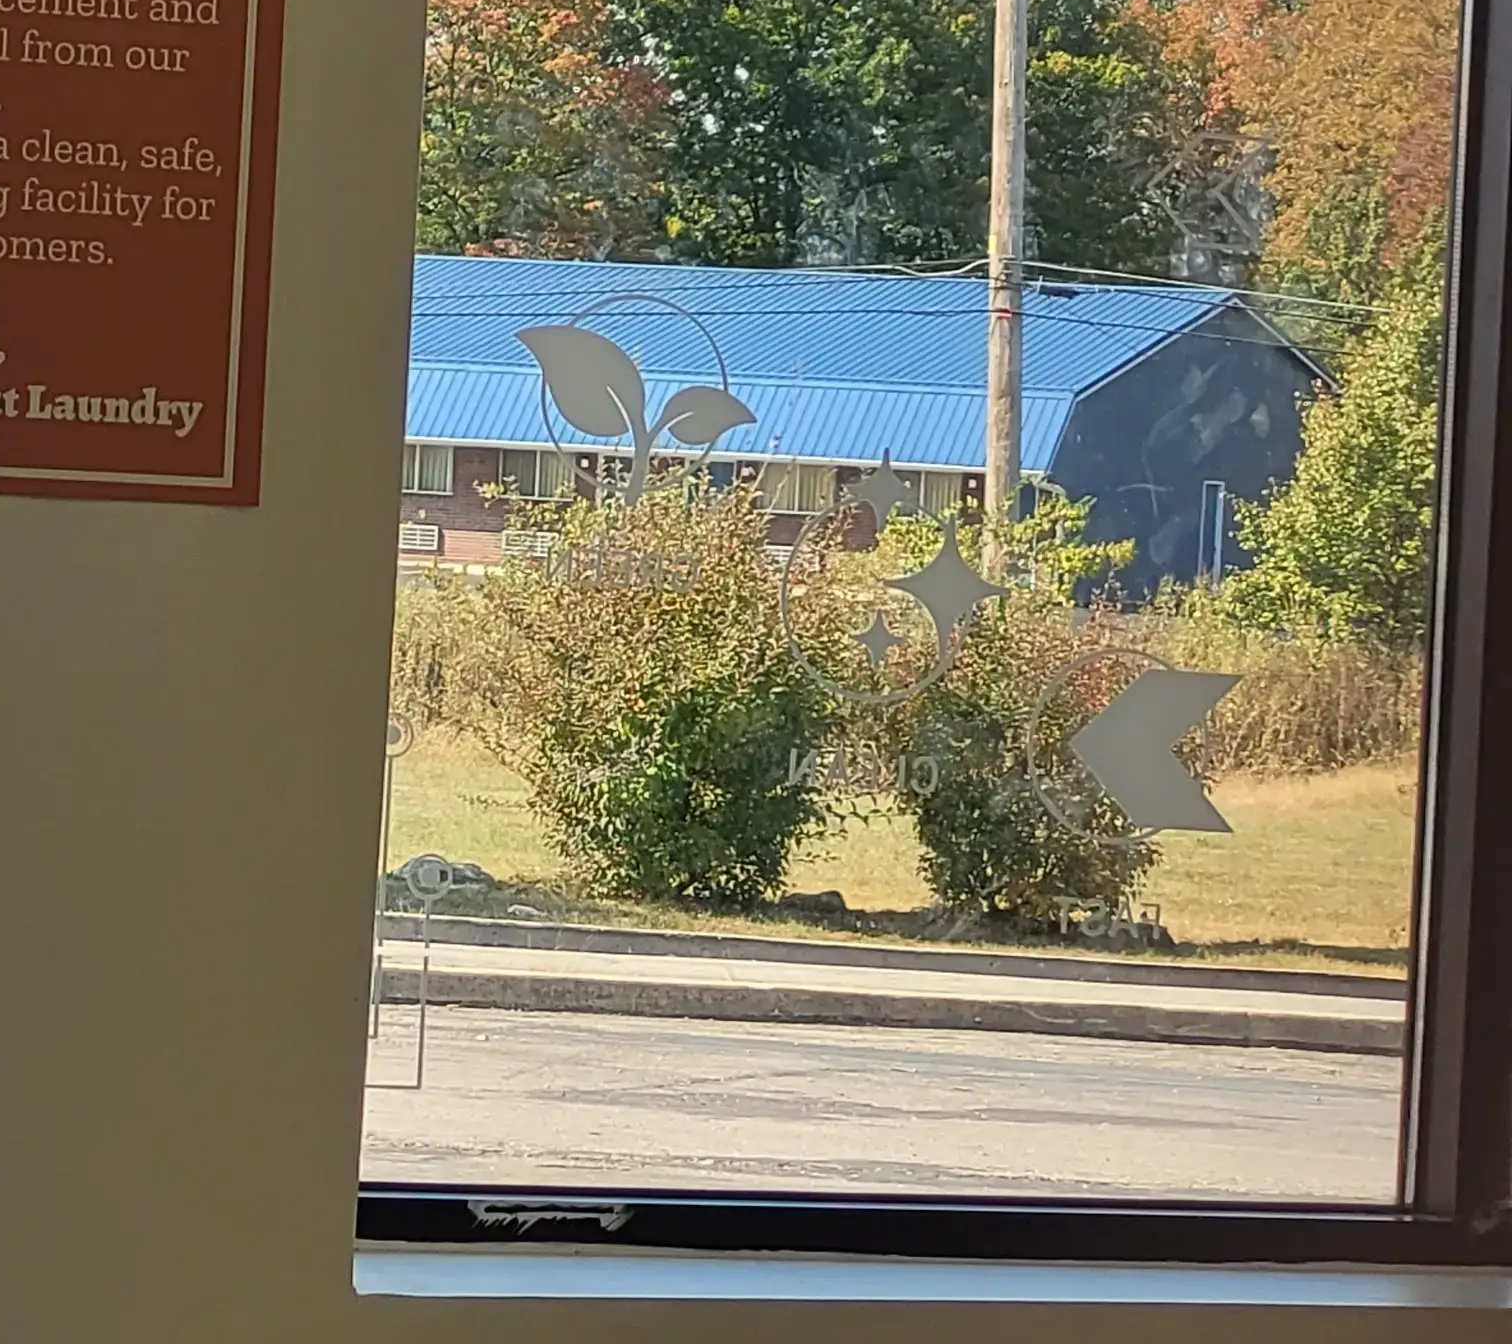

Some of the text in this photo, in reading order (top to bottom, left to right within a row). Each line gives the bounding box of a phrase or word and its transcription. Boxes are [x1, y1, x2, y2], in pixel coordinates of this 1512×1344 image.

[21, 29, 113, 67] from
[126, 47, 189, 71] our
[23, 129, 126, 171] clean,
[141, 138, 221, 176] safe,
[21, 177, 152, 226] facility
[162, 186, 215, 220] for
[26, 385, 203, 437] Laundry
